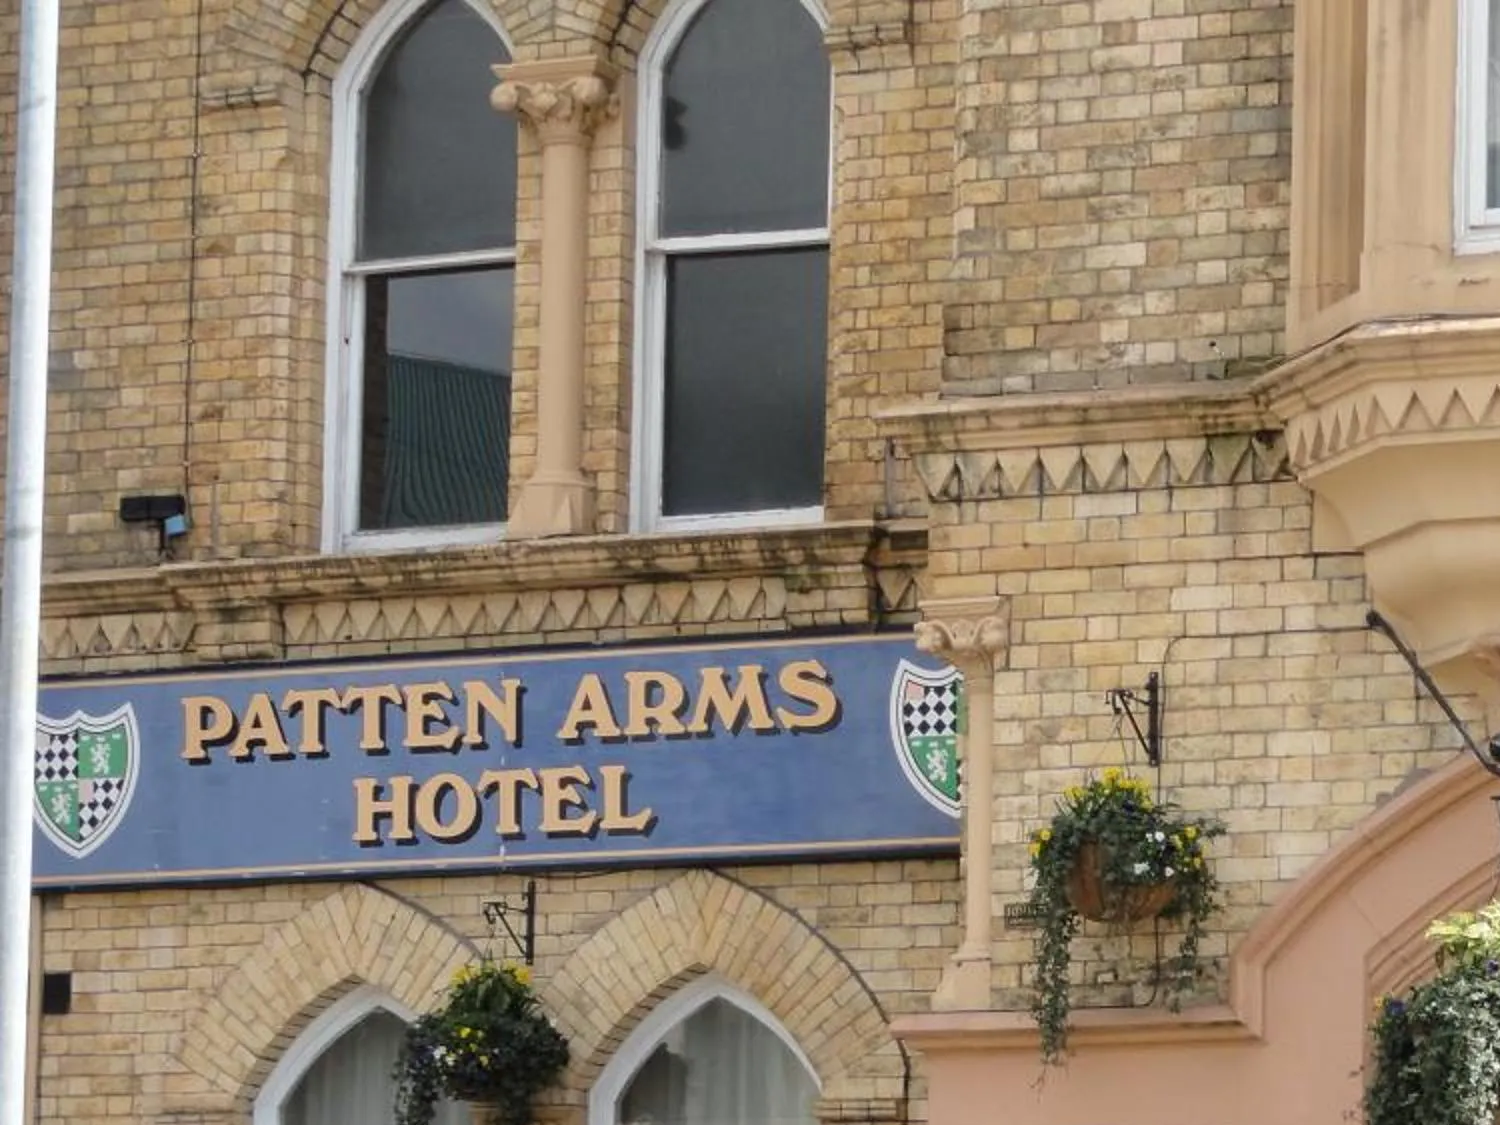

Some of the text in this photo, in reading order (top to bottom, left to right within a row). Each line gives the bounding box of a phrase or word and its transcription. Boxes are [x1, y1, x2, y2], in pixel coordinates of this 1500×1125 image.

[180, 659, 842, 762] PATTEN ARMS
[352, 764, 653, 842] HOTEL
